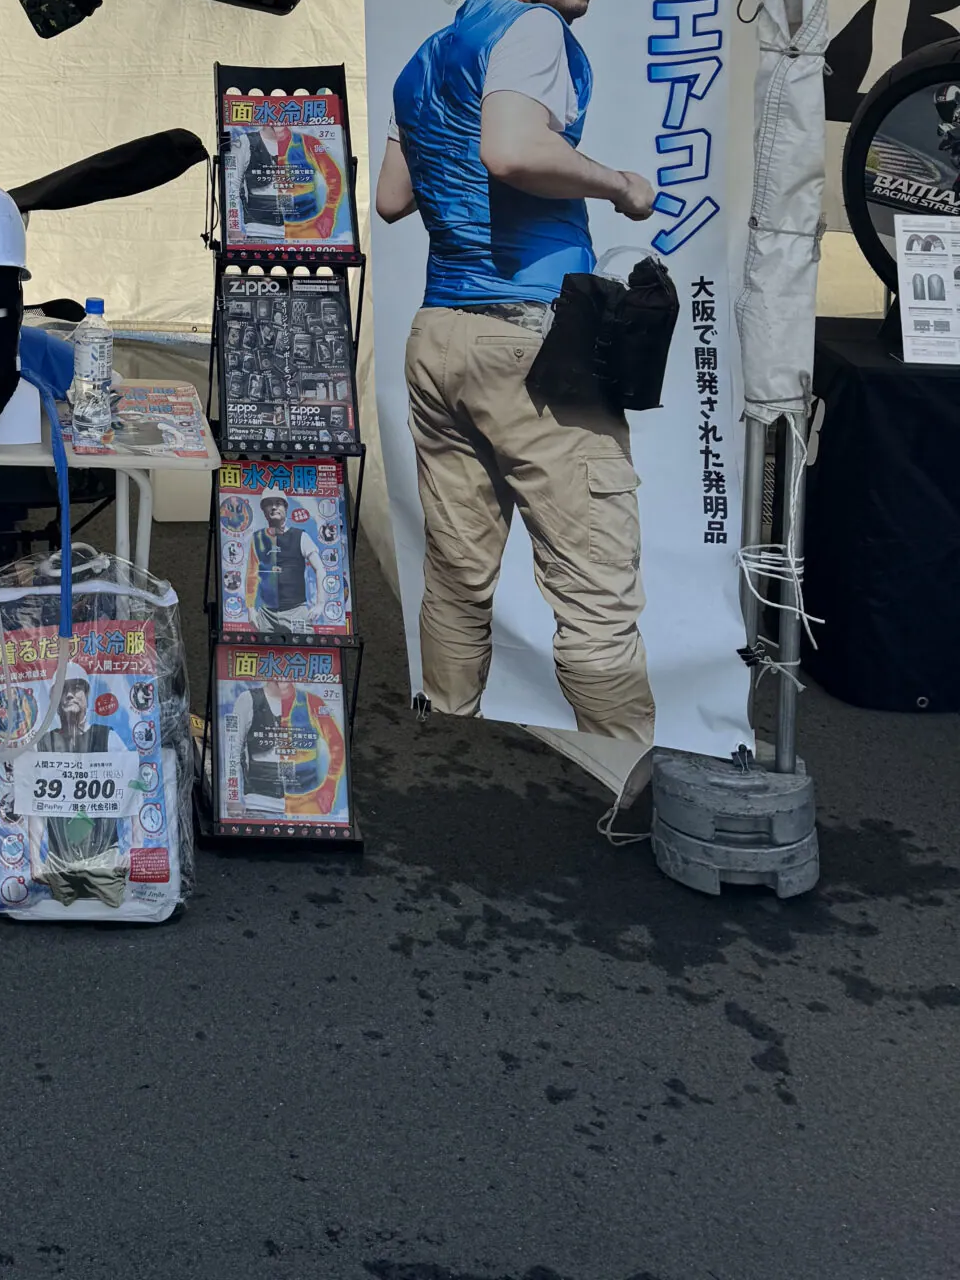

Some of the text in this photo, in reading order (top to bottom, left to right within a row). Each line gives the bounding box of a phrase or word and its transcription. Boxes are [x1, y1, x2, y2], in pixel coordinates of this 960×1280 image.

[231, 101, 327, 123] 面水冷服
[309, 116, 334, 125] 2024
[872, 186, 919, 205] RACING
[874, 172, 960, 206] BATTLA
[228, 209, 239, 230] 爆速
[690, 275, 728, 544] 大阪で開発された発明品
[220, 464, 317, 490] 面水冷服
[235, 651, 332, 678] 面水冷服
[314, 673, 340, 683] 2024
[228, 777, 239, 800] 爆速
